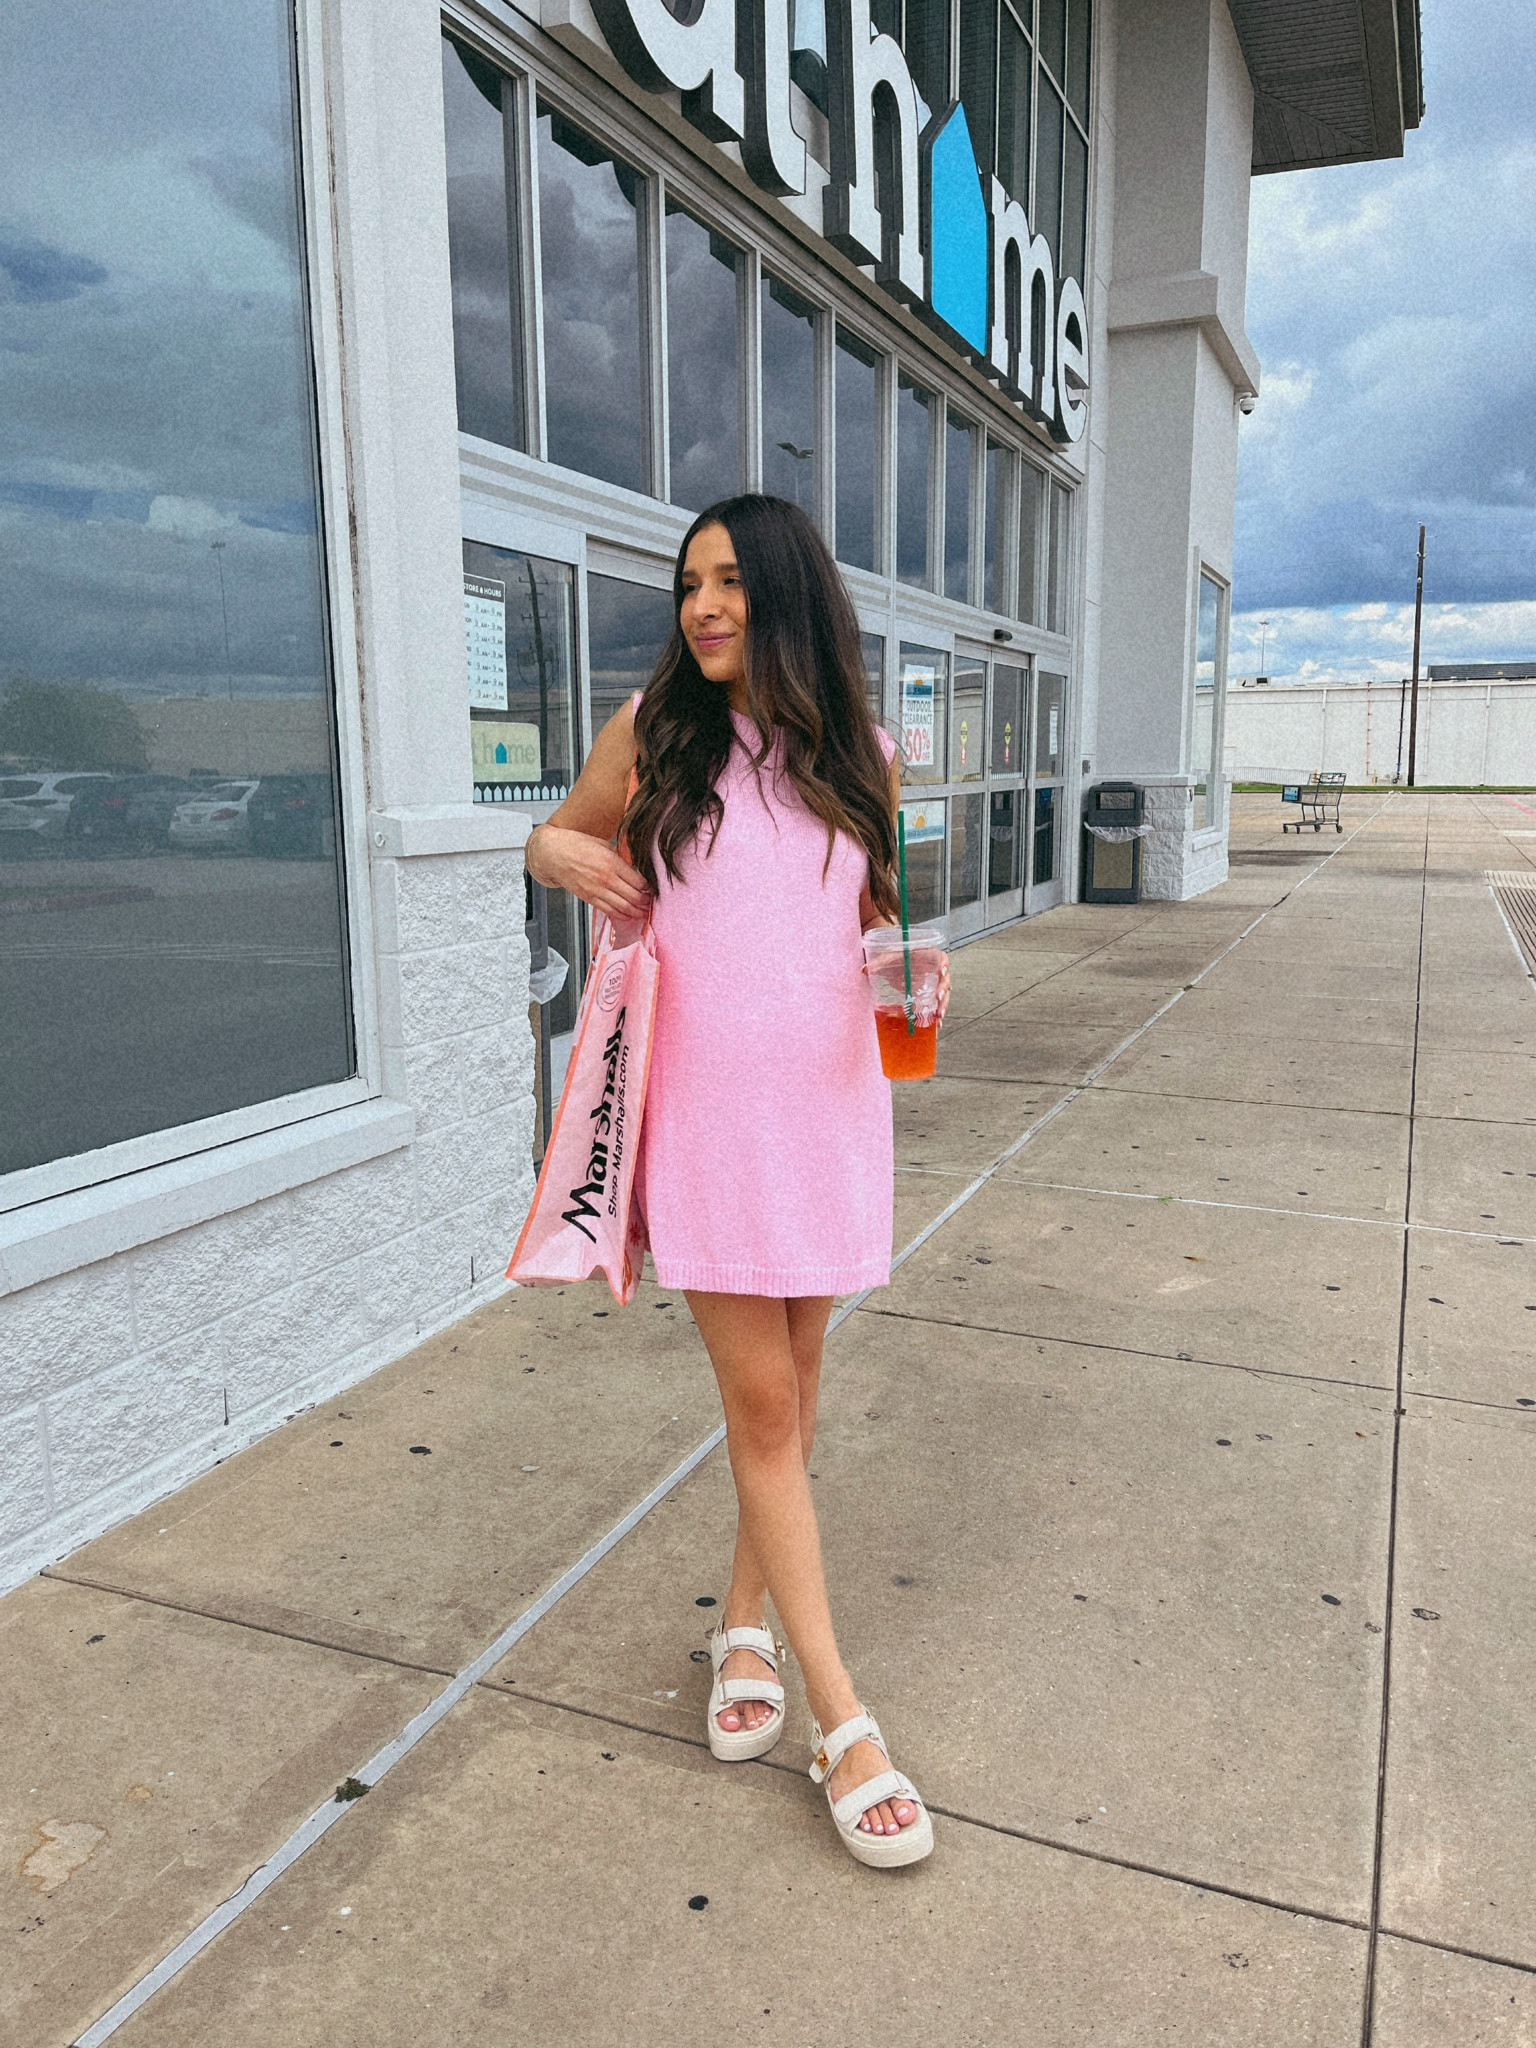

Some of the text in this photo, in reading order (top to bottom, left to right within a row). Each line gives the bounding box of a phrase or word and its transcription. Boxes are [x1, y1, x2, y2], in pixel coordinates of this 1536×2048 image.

[484, 587, 502, 598] HOURS
[906, 700, 931, 713] OUTDOOR
[904, 713, 933, 725] CLEARANCE
[905, 727, 931, 762] 50%
[561, 1006, 626, 1244] Marshalls
[609, 1045, 629, 1218] Shop Marshalls.com
